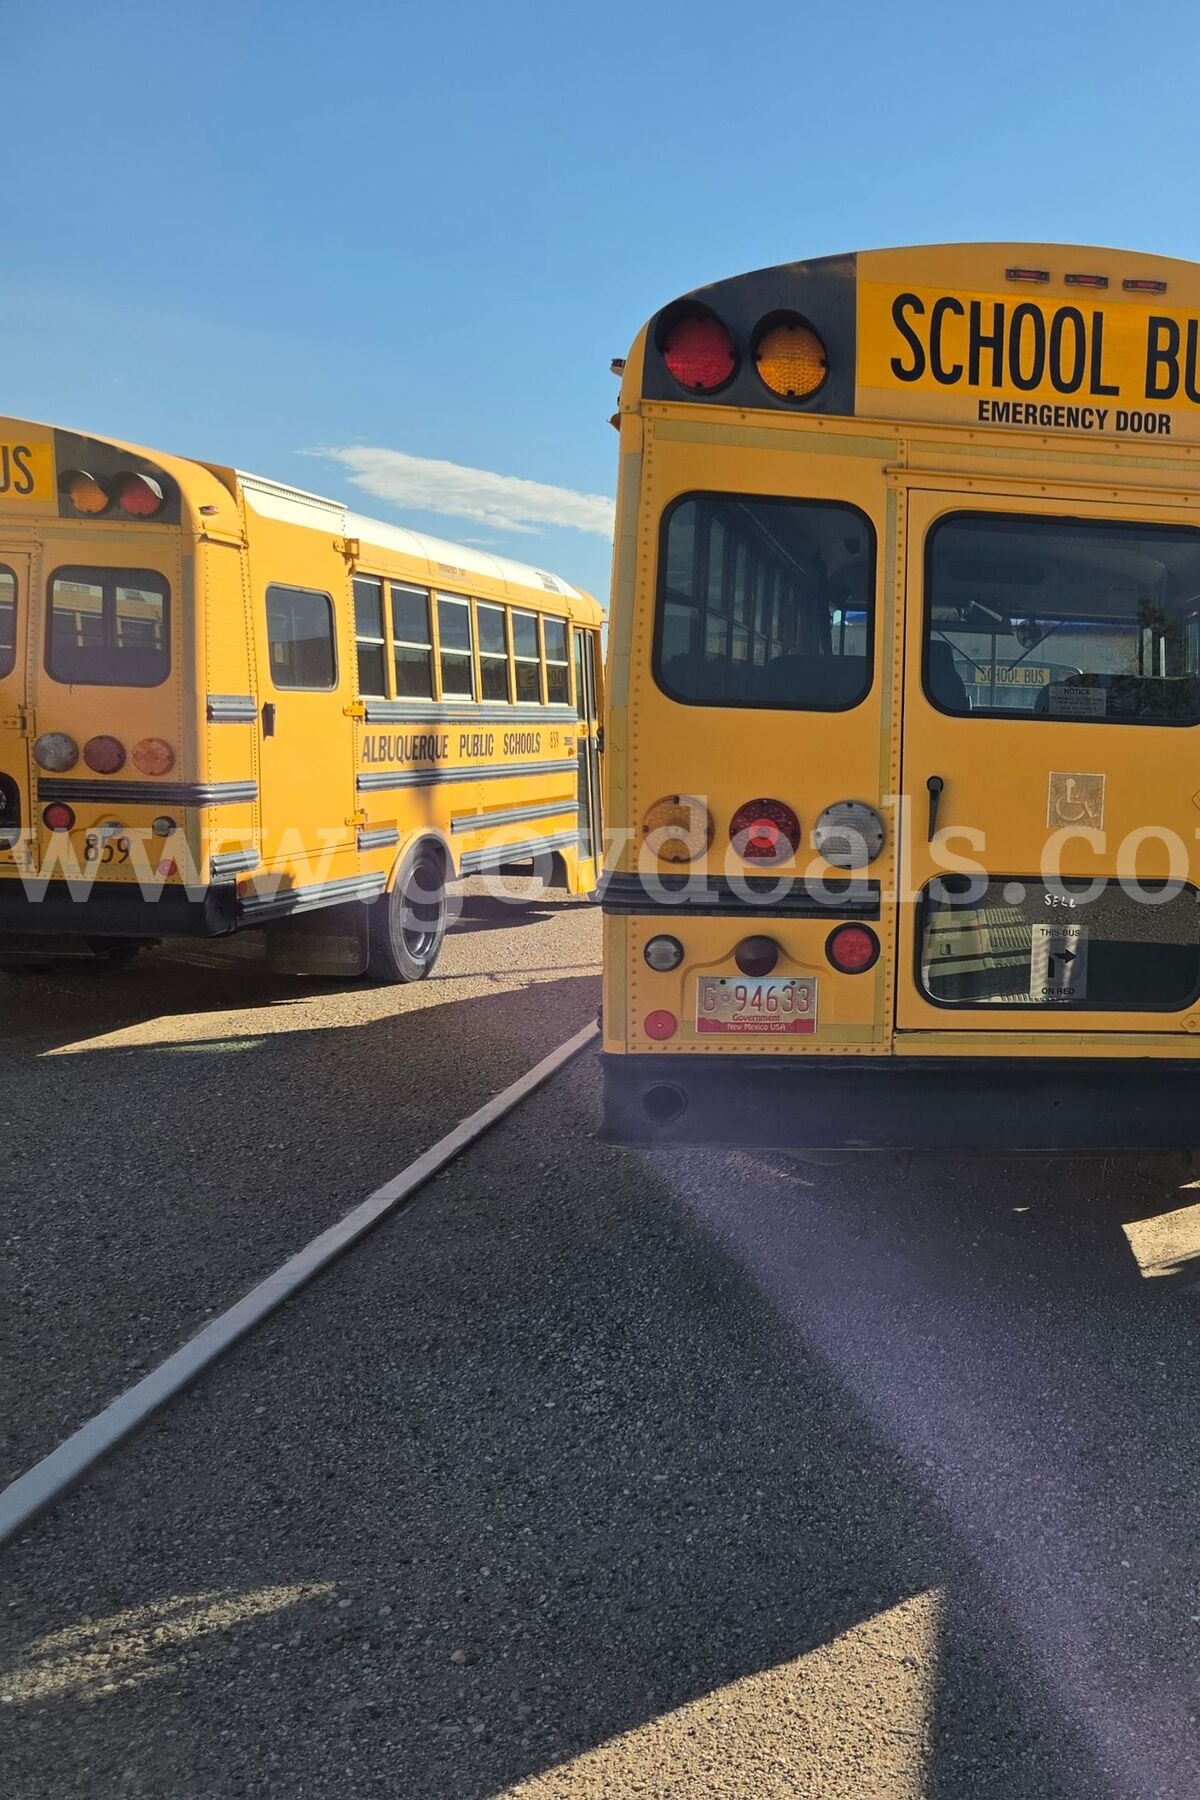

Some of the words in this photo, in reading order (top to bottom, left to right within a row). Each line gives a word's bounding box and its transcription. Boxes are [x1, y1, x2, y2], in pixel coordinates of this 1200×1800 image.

[890, 293, 1120, 397] SCHOOL
[978, 400, 1108, 431] EMERGENCY
[1116, 411, 1172, 435] DOOR
[980, 666, 1020, 682] SCHOOL
[1024, 669, 1045, 684] BUS
[1064, 687, 1091, 695] NOTICE
[362, 734, 449, 764] ALBUQUERQUE
[459, 733, 494, 758] PUBLIC
[503, 732, 541, 755] SCHOOLS
[84, 834, 131, 864] 859
[1040, 928, 1059, 936] THIS
[1062, 929, 1081, 937] BUS
[1041, 987, 1054, 995] ON
[1057, 987, 1075, 995] RED
[732, 1013, 781, 1022] Government
[744, 1023, 768, 1031] Mexico
